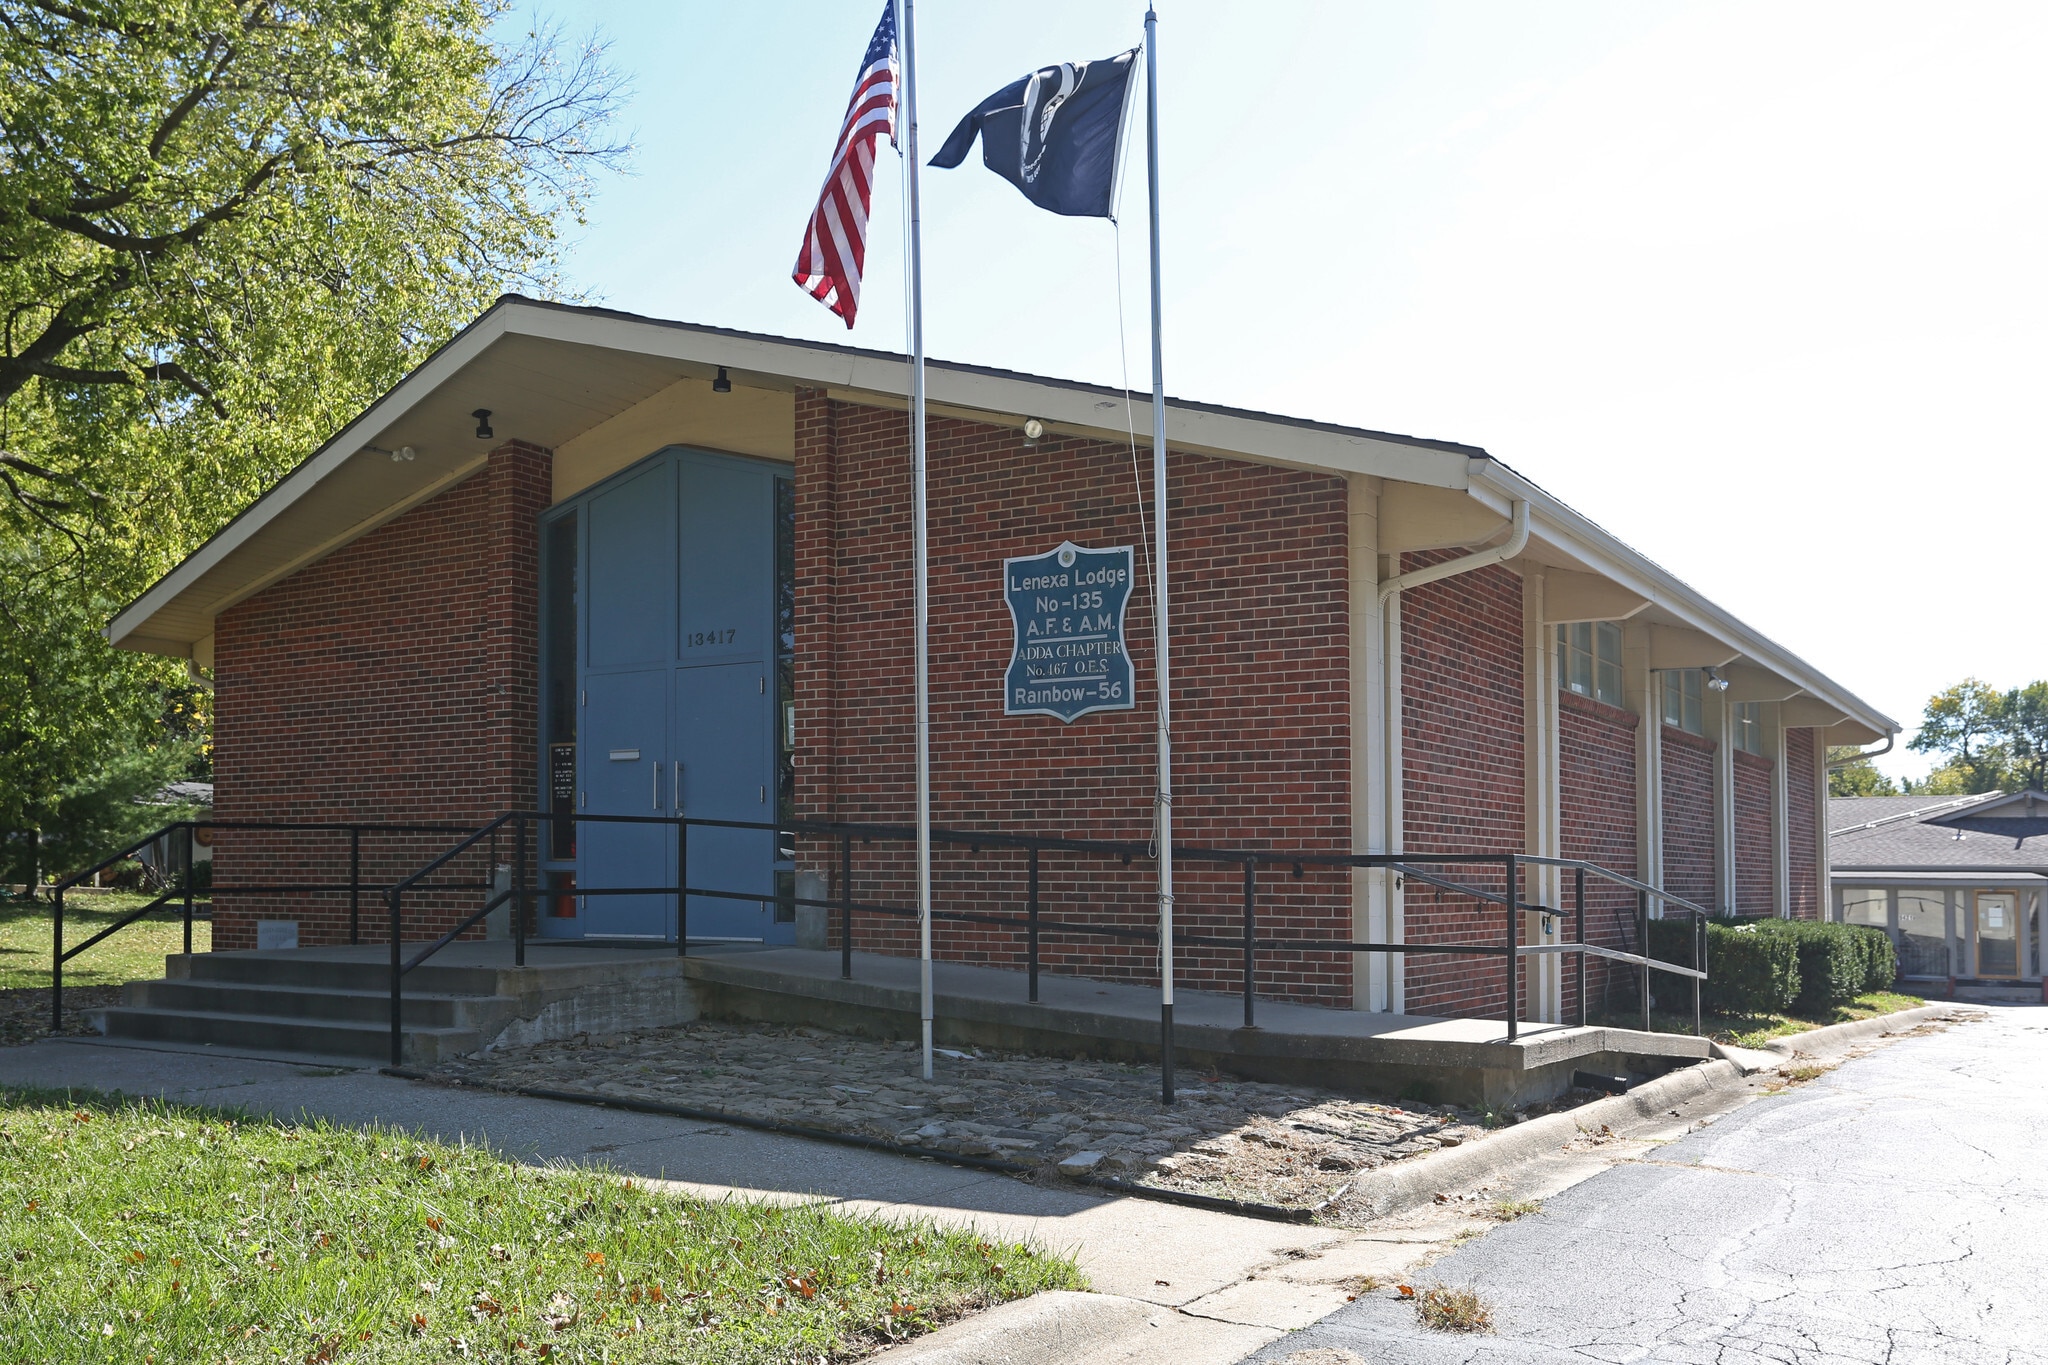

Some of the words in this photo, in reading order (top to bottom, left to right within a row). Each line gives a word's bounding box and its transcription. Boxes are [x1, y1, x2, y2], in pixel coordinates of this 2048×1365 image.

[1011, 573, 1069, 592] Lenexa
[1075, 566, 1126, 589] Lodge
[1026, 618, 1058, 637] A.F.
[1062, 617, 1072, 633] &
[1079, 613, 1116, 633] A.M.
[687, 629, 736, 648] 13417
[1017, 646, 1054, 661] ADDA
[1056, 640, 1122, 658] CHAPTER
